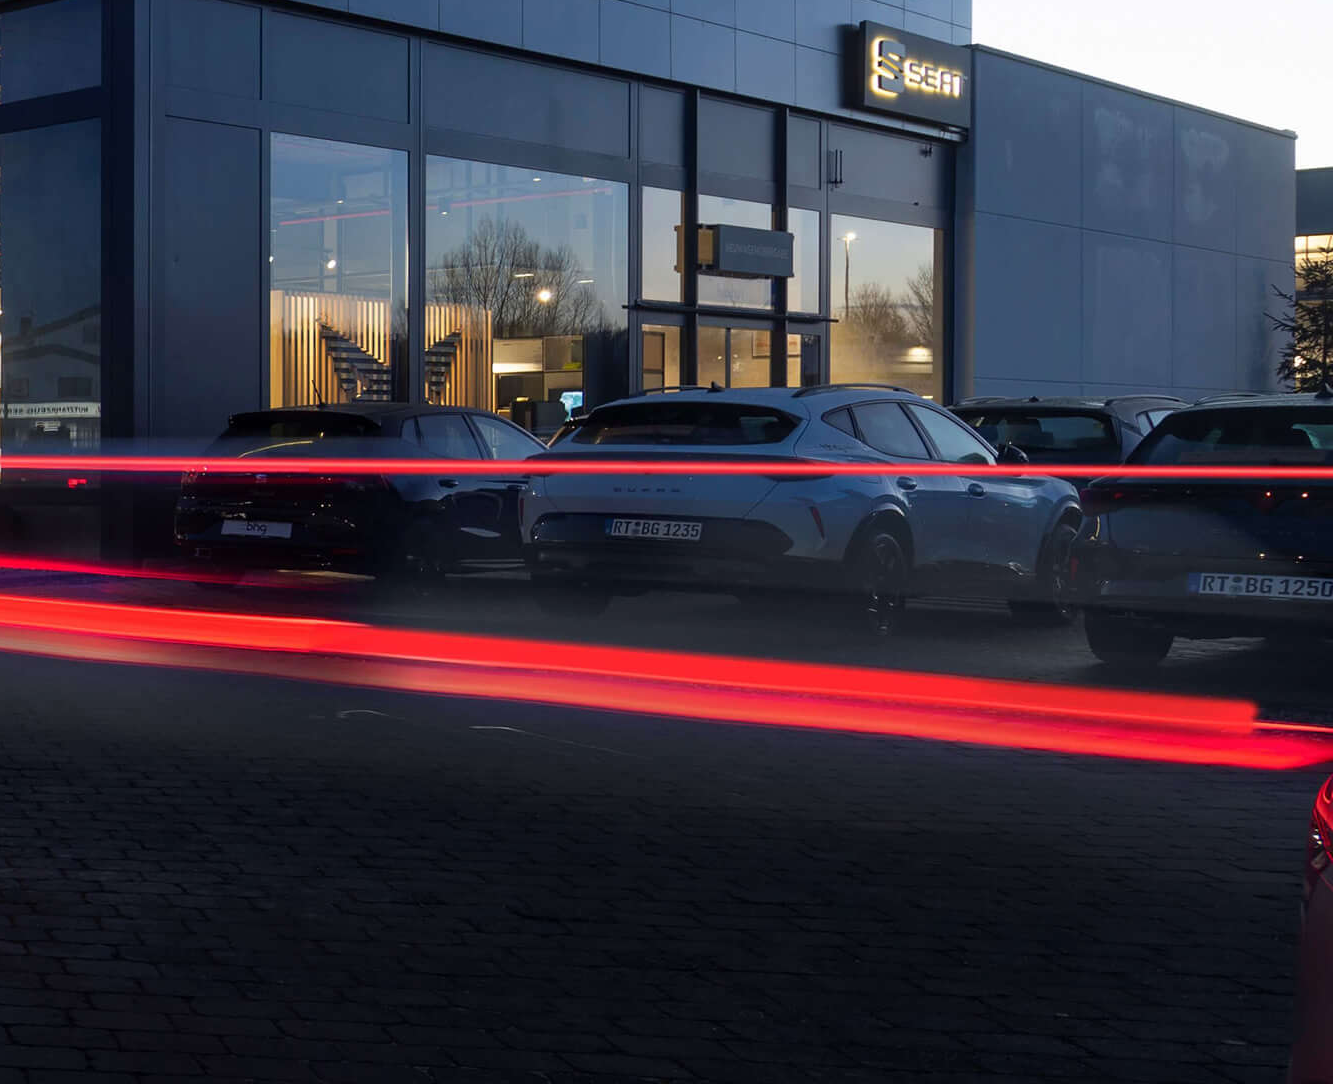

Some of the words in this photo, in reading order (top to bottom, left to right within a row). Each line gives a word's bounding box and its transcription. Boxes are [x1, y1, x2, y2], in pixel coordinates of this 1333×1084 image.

[907, 60, 967, 97] SEAT
[613, 520, 631, 534] RT
[641, 522, 660, 535] BG
[662, 523, 700, 537] 1235
[1201, 575, 1229, 592] RT
[1244, 577, 1273, 594] BG
[1277, 579, 1333, 597] 1250
